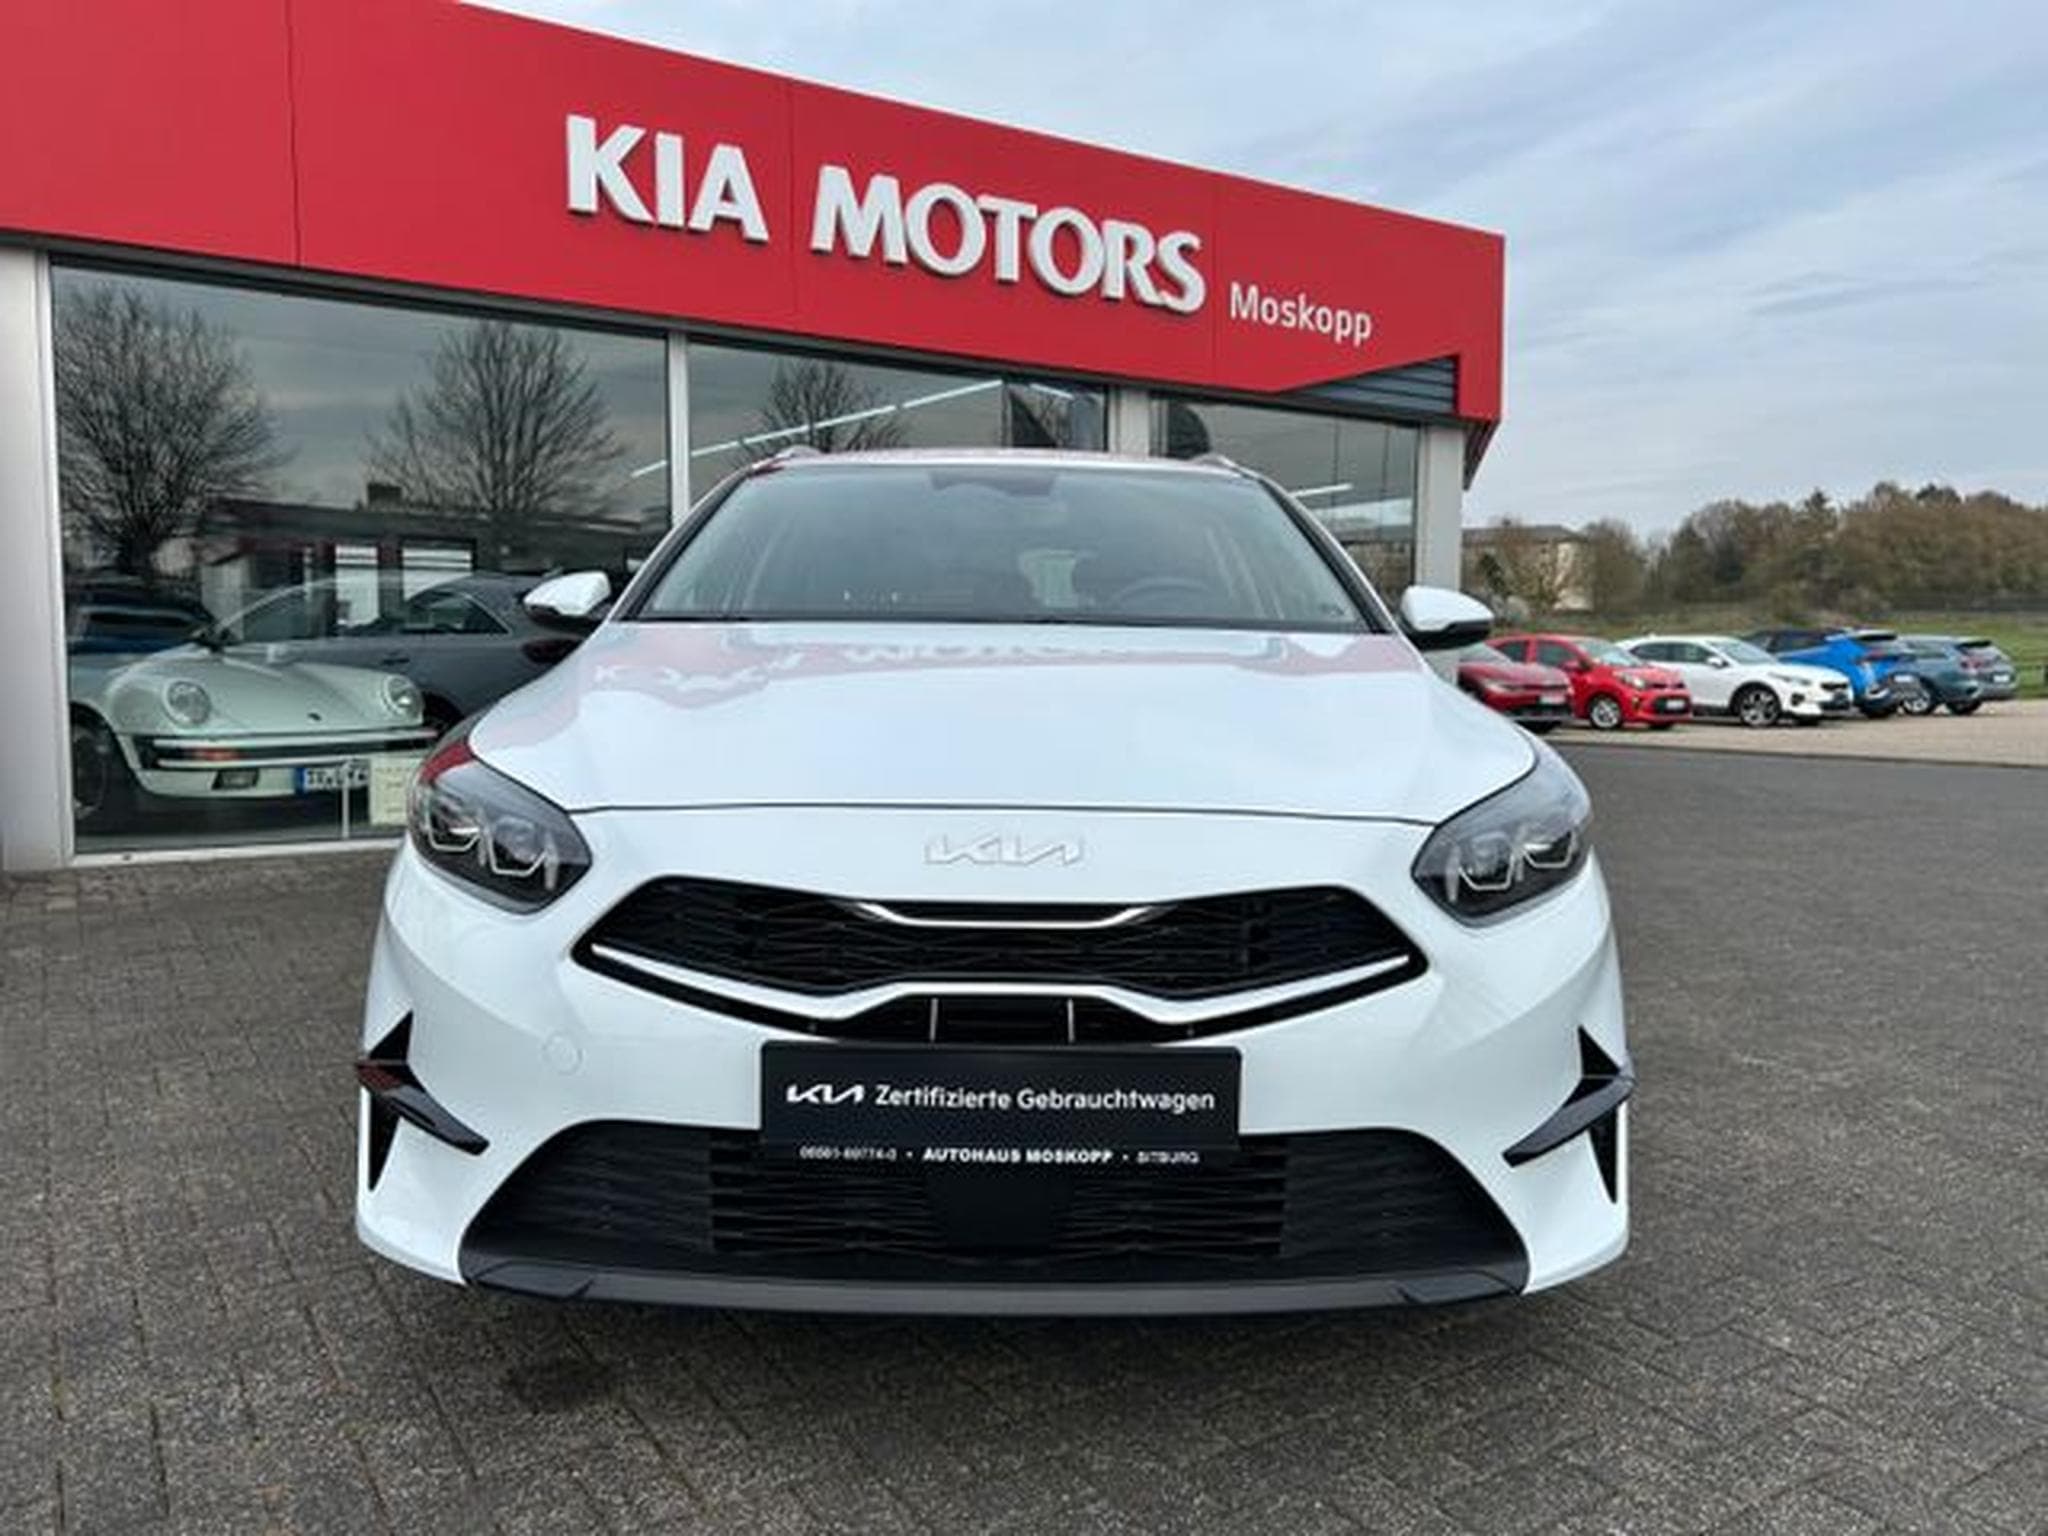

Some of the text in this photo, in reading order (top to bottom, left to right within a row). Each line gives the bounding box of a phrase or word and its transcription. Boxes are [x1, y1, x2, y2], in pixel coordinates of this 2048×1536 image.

[566, 114, 1207, 314] KIA MOTORS
[1230, 282, 1374, 346] Moskopp
[924, 832, 1086, 867] KIA
[786, 1083, 1216, 1115] KIA Zertifizierte Gebrauchtwagen
[922, 1147, 1022, 1163] AUTOHAUS
[1025, 1148, 1114, 1164] MOSKOPP
